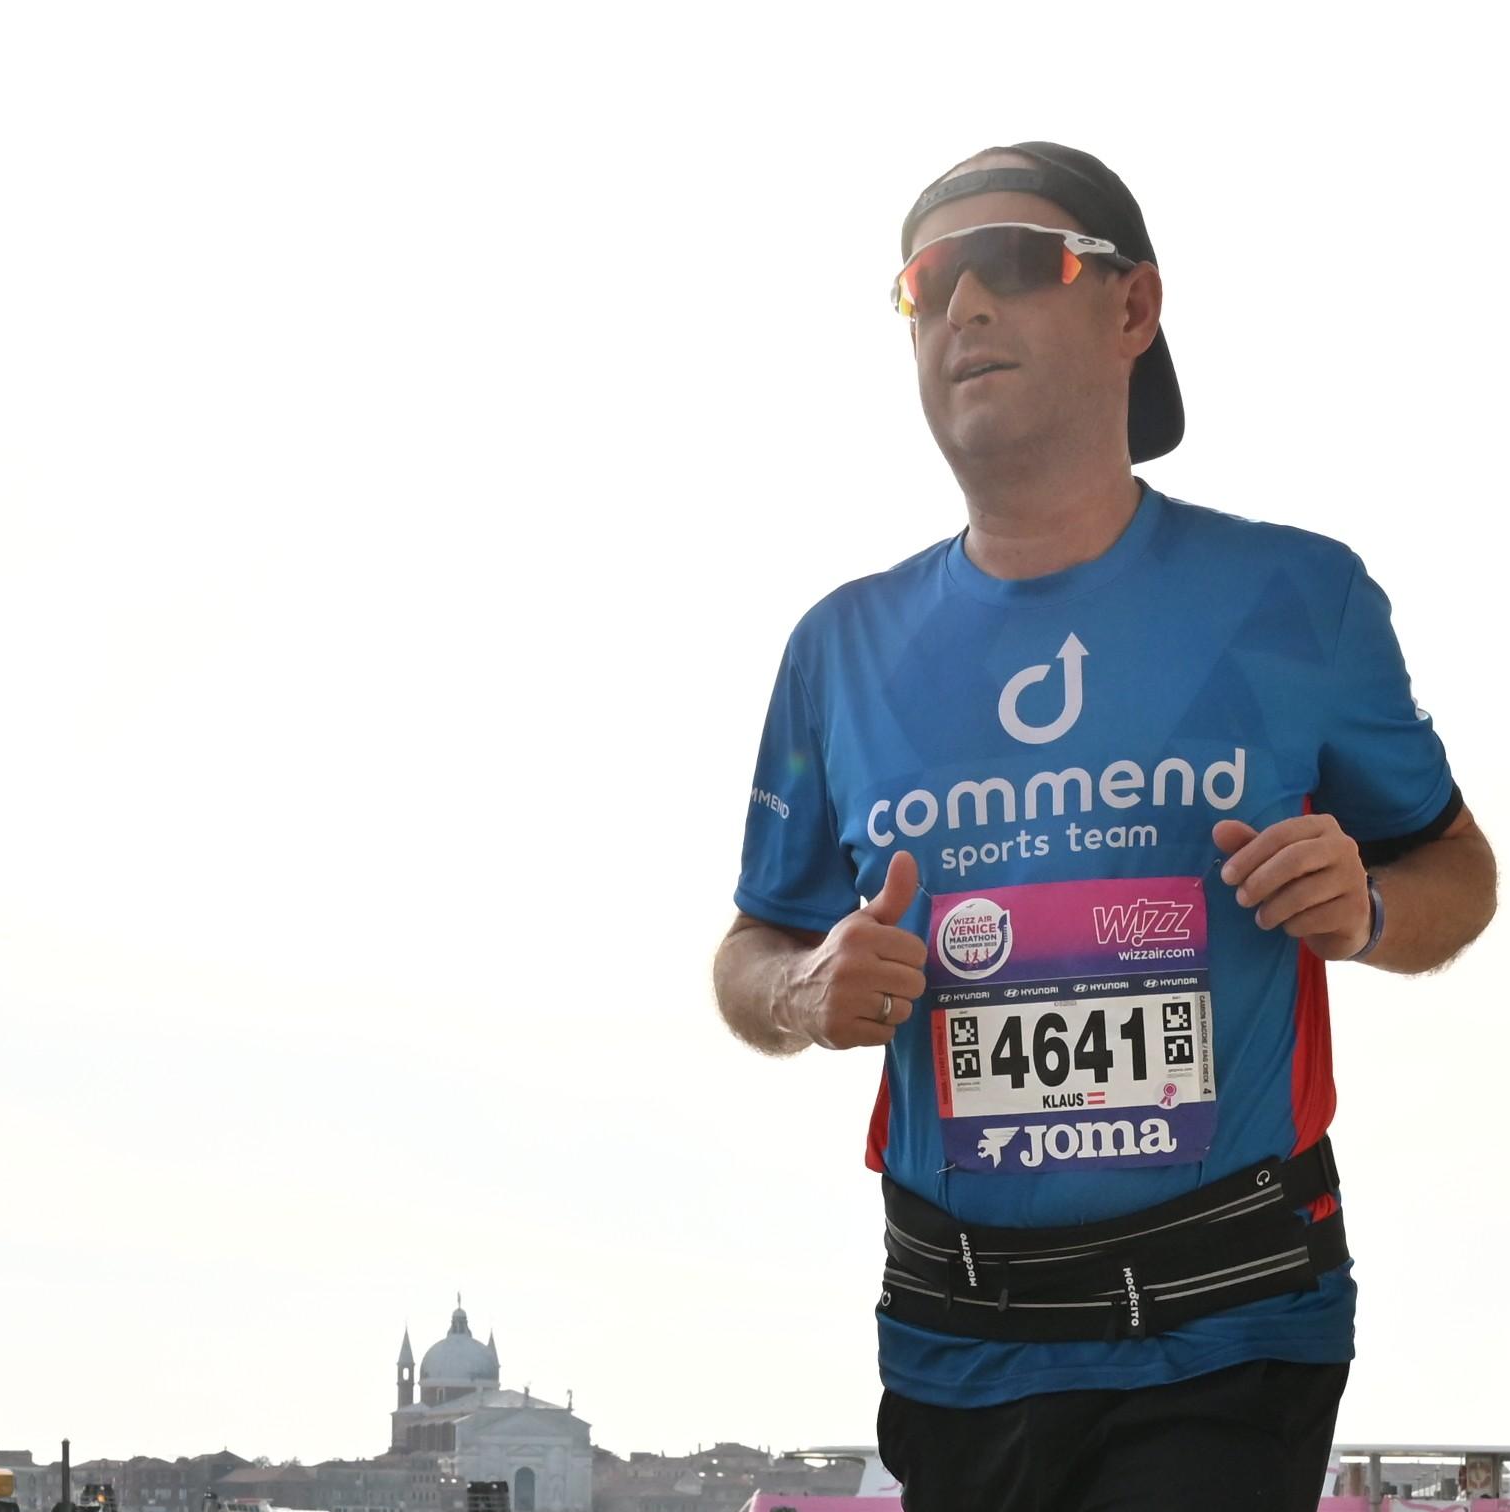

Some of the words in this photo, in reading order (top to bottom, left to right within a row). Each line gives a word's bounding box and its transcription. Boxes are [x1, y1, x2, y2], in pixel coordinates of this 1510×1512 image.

[867, 748, 1245, 848] commend
[941, 829, 1050, 876] sports
[1066, 822, 1158, 852] team
[953, 916, 976, 926] WIZZ
[978, 915, 993, 924] AIR
[950, 923, 997, 937] VENICE
[949, 933, 997, 945] MARATHON
[1118, 947, 1195, 961] wizzair.com
[1089, 981, 1129, 991] HYUNDAI
[1160, 977, 1198, 987] HYUNDAI
[952, 991, 990, 1002] HYUNDAI
[1021, 986, 1059, 996] HYUNDAI
[990, 1006, 1148, 1089] 4641
[1042, 1092, 1084, 1109] KLAUS
[1123, 1267, 1139, 1327] MOCOCITO
